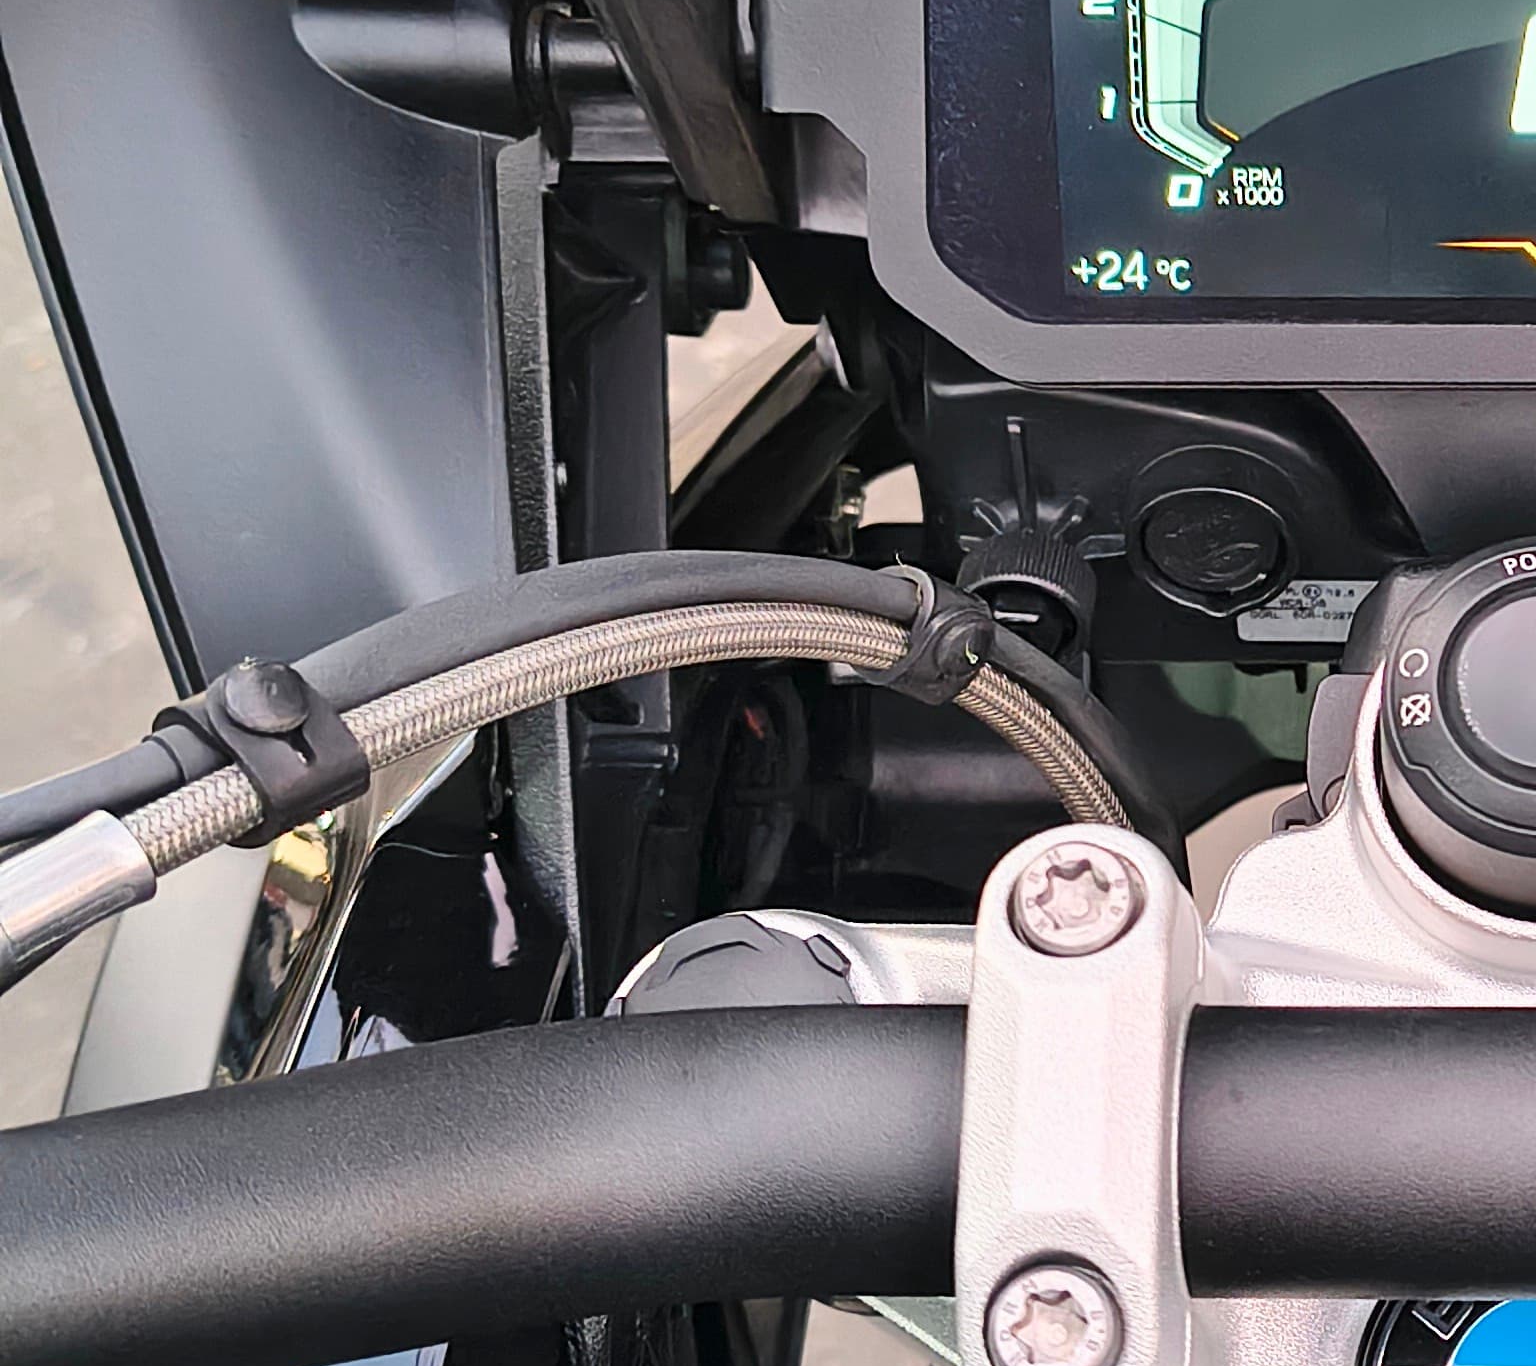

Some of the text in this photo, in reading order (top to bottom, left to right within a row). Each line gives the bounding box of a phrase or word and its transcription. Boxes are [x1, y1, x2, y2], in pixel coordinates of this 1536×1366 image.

[1101, 86, 1117, 120] 1
[1167, 174, 1203, 207] 0
[1232, 167, 1284, 187] RPM
